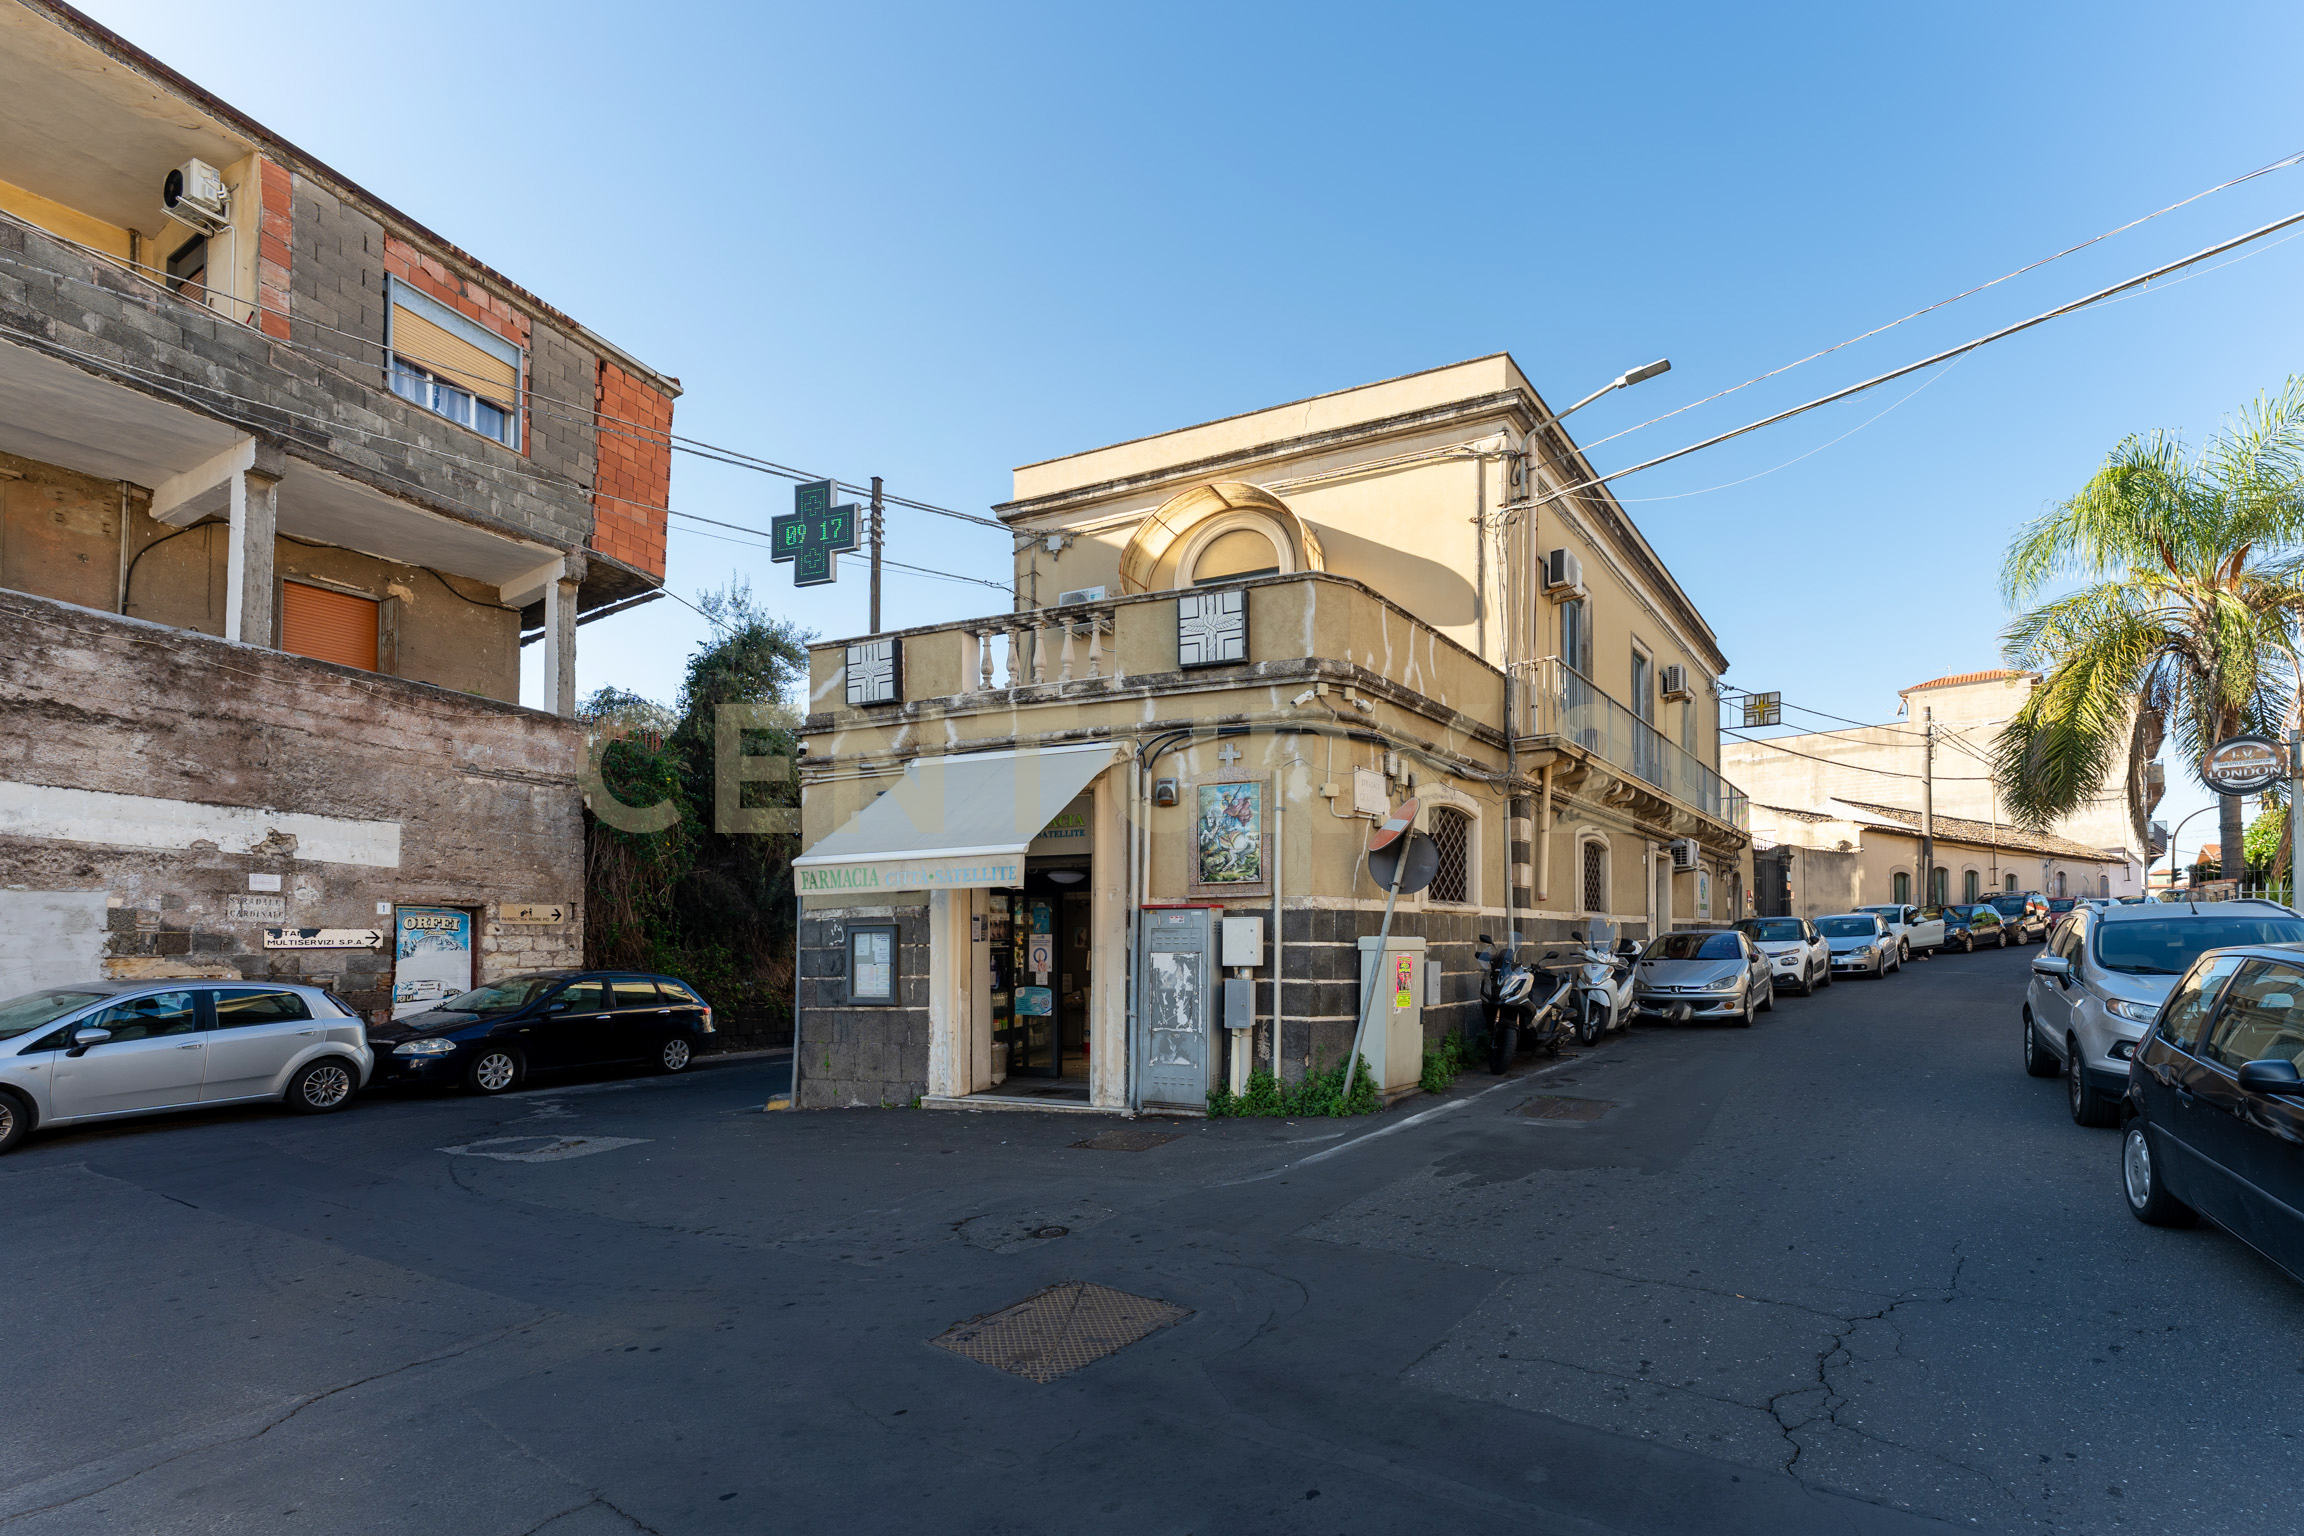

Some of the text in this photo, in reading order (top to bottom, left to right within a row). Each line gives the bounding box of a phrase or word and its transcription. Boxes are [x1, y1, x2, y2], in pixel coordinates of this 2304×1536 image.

[785, 518, 843, 546] 09 17
[2209, 765, 2282, 780] LONDON
[1047, 814, 1085, 828] ACIA
[801, 867, 880, 891] FARMACIA
[403, 915, 461, 931] ORFEI
